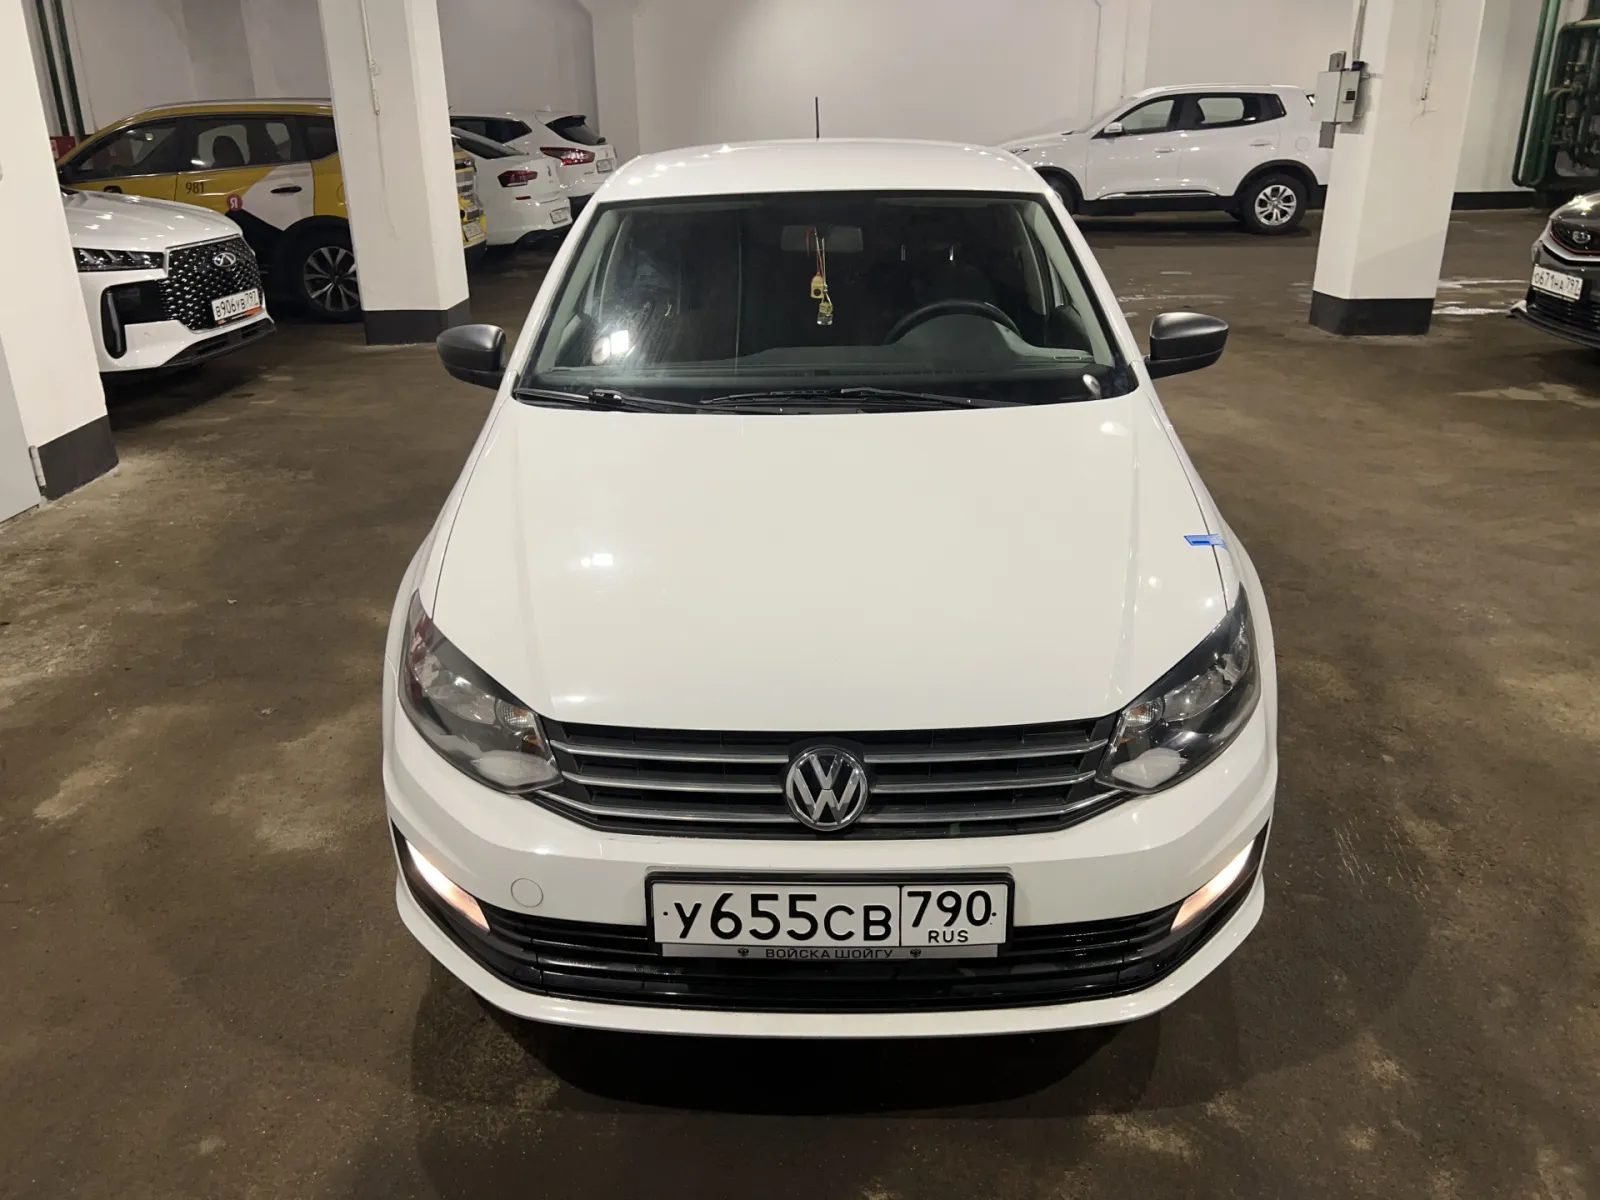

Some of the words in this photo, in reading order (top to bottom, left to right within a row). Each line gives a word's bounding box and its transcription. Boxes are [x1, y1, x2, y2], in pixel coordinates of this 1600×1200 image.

[185, 181, 204, 194] 981
[674, 892, 892, 941] У655СВ
[907, 890, 992, 927] 790
[928, 930, 969, 943] RUS
[765, 948, 830, 960] ВОЙСКА
[835, 948, 893, 959] ШОЙГУ
